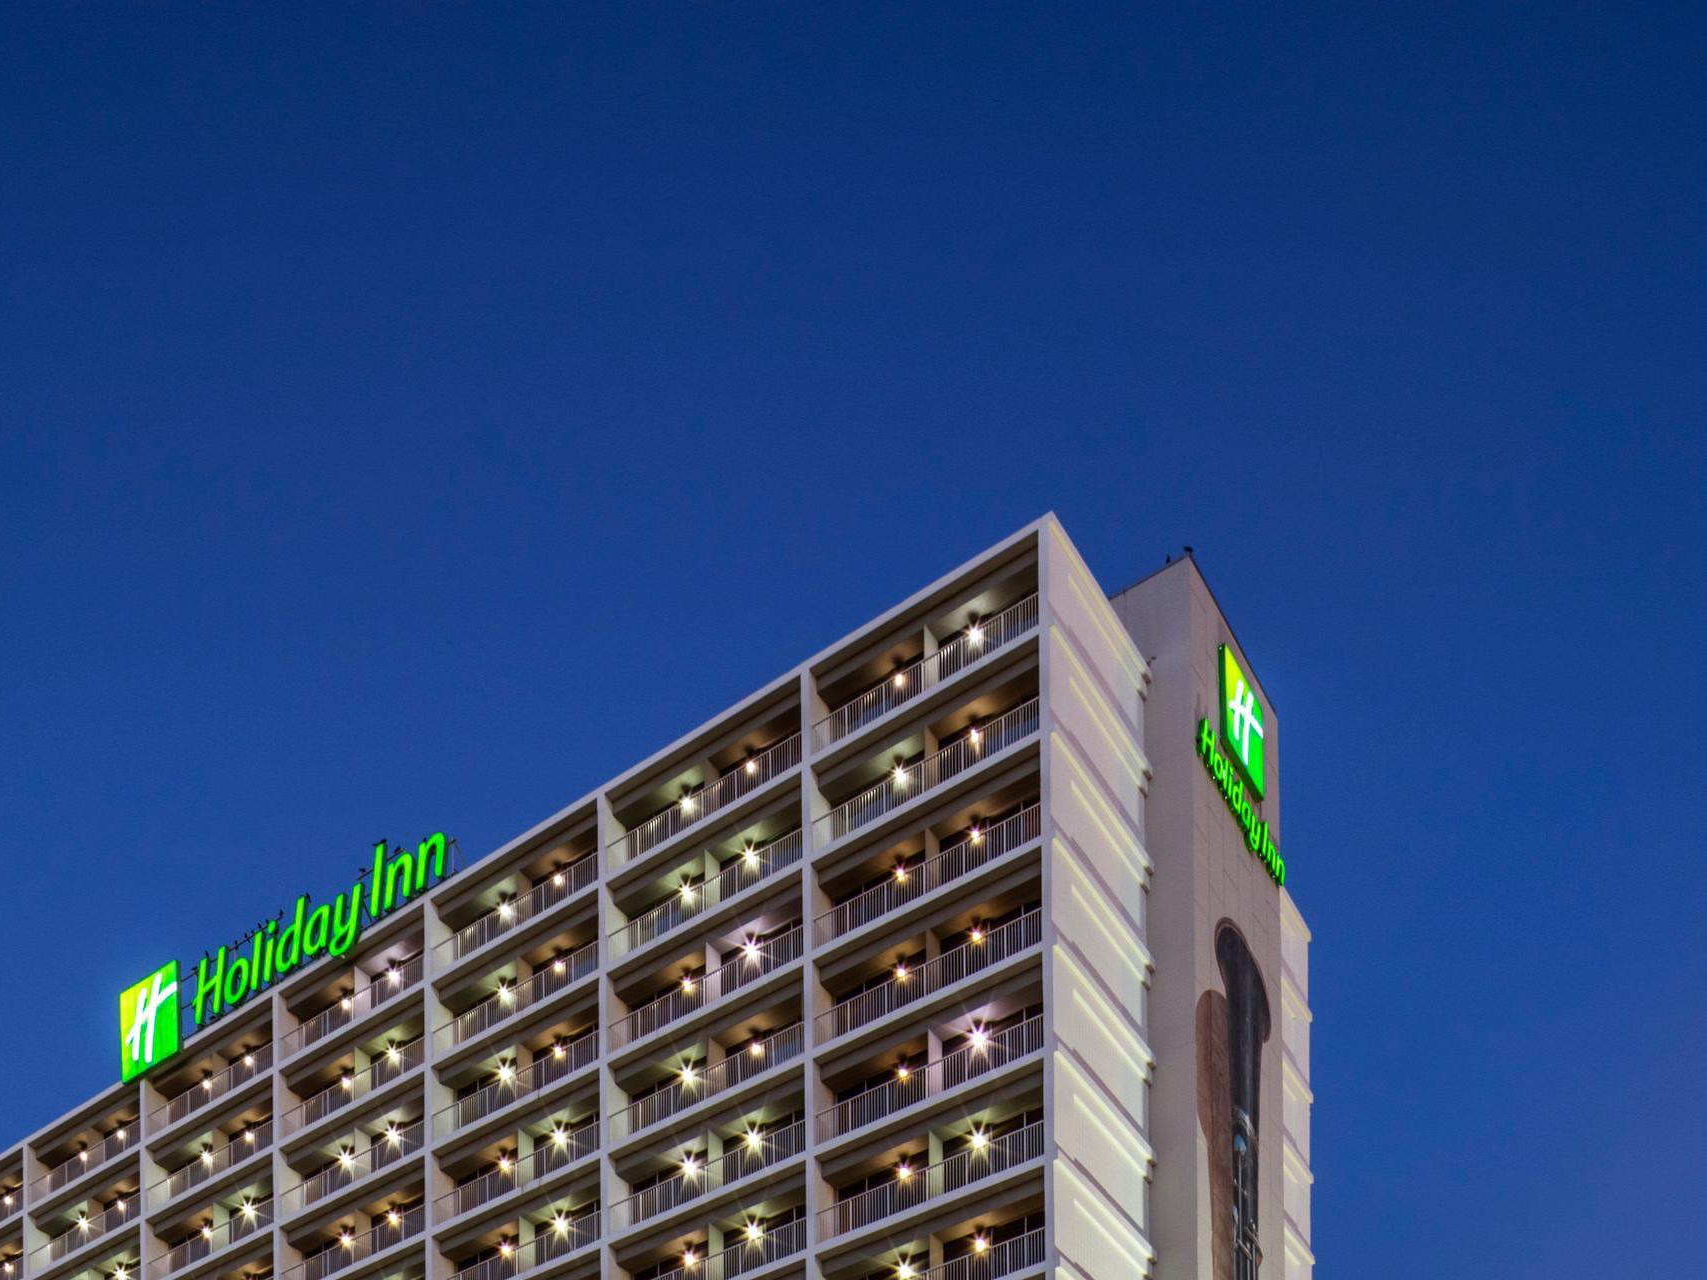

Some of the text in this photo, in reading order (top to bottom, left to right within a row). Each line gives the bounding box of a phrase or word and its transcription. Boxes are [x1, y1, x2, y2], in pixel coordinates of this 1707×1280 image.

[1198, 717, 1286, 886] Holiday Inn
[191, 831, 448, 1026] Holiday Inn
